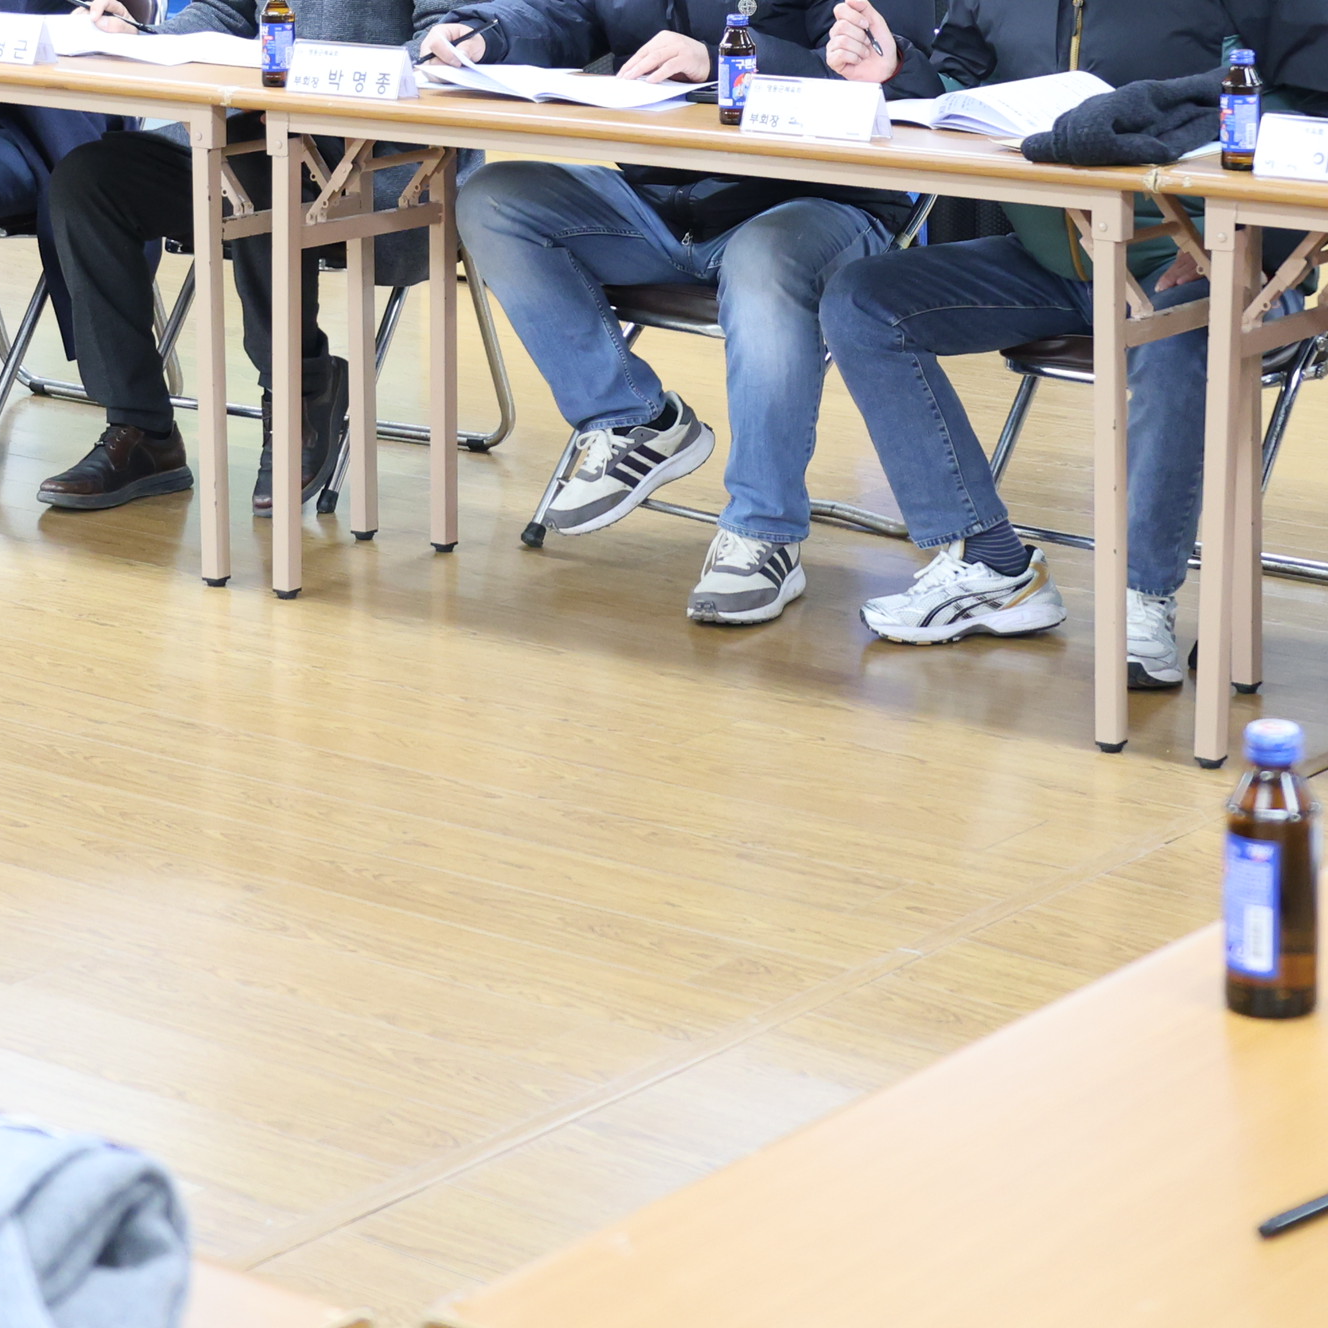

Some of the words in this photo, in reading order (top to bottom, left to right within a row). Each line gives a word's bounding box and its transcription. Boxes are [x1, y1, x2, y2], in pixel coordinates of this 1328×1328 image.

[294, 76, 320, 89] 부회장
[328, 69, 391, 95] 박명종
[749, 113, 779, 128] 부회장
